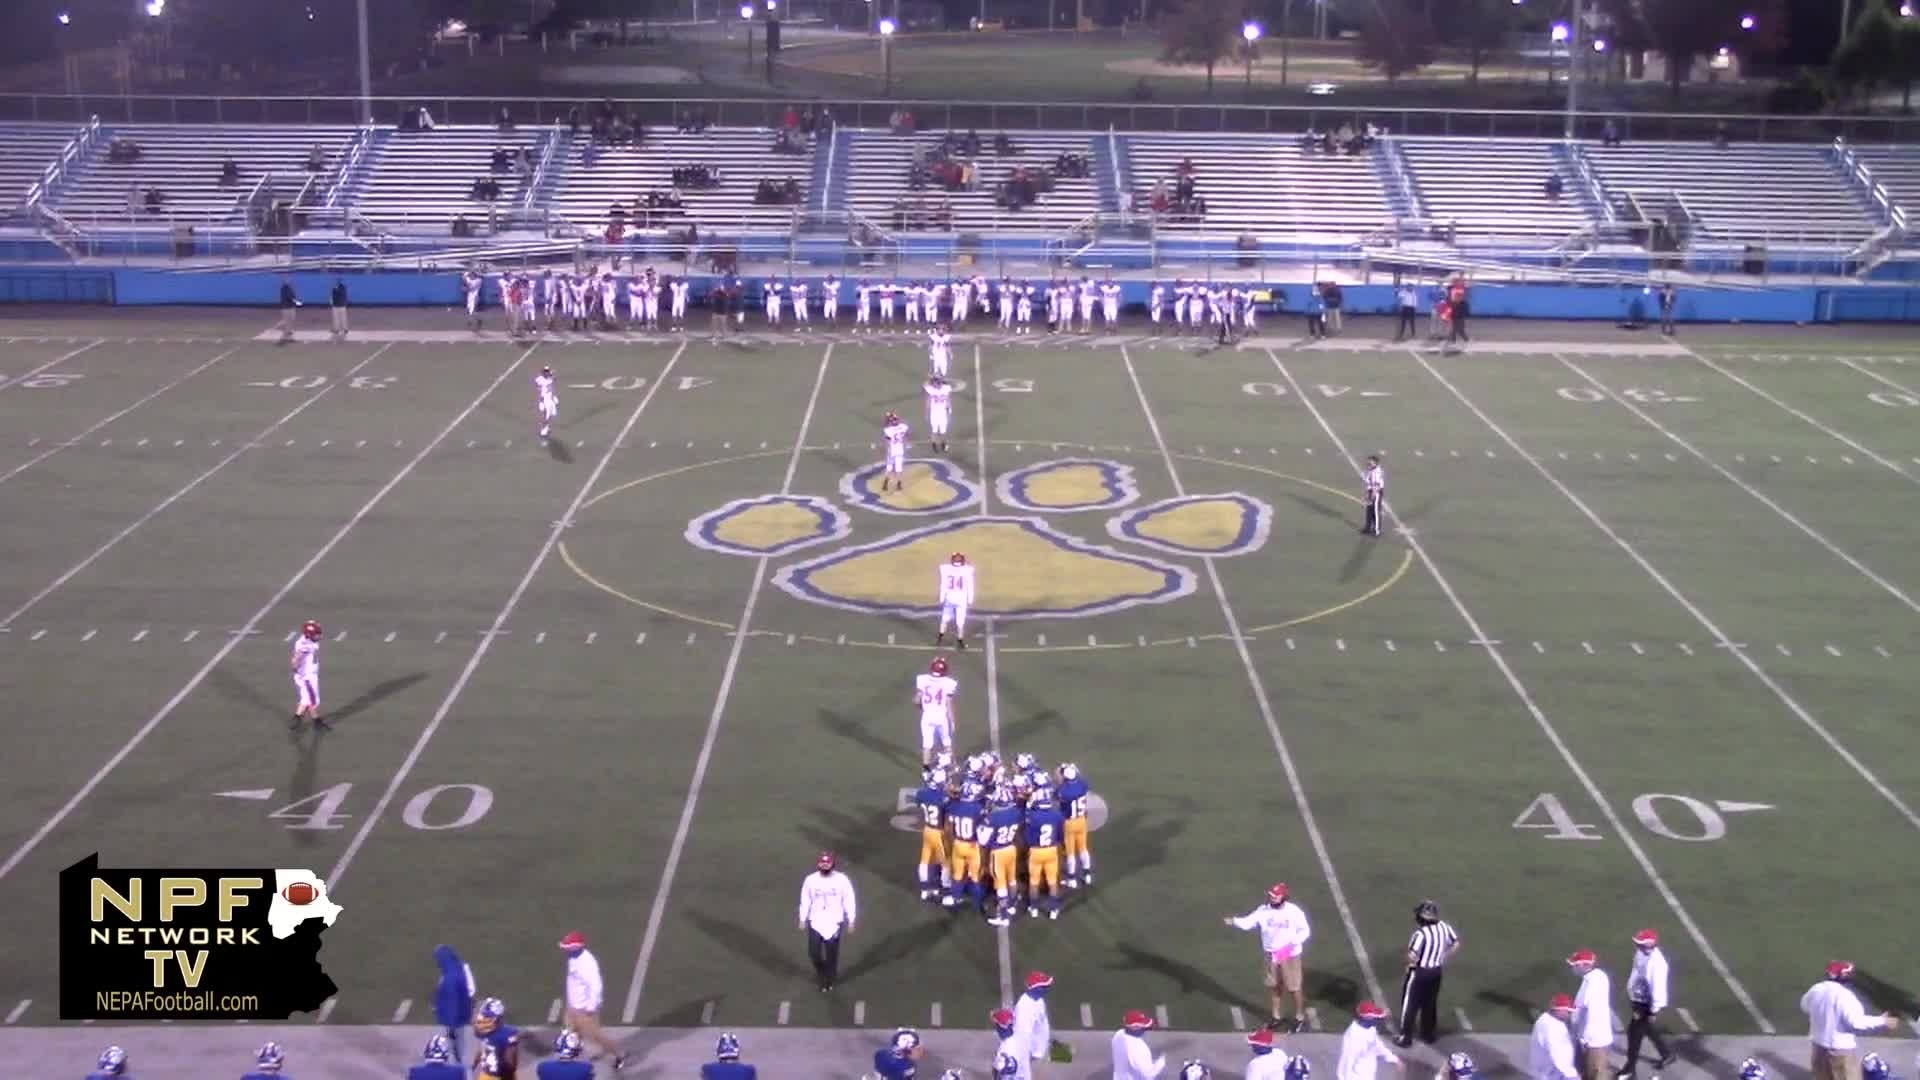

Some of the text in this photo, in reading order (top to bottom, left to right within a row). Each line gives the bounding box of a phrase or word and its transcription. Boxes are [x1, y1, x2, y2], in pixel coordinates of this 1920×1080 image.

[946, 575, 964, 591] 34
[923, 685, 944, 706] 54
[267, 782, 494, 830] 40
[920, 802, 939, 825] 12
[1070, 796, 1088, 818] 15
[1512, 792, 1726, 841] 40
[954, 815, 973, 839] 10
[1040, 823, 1053, 846] 2
